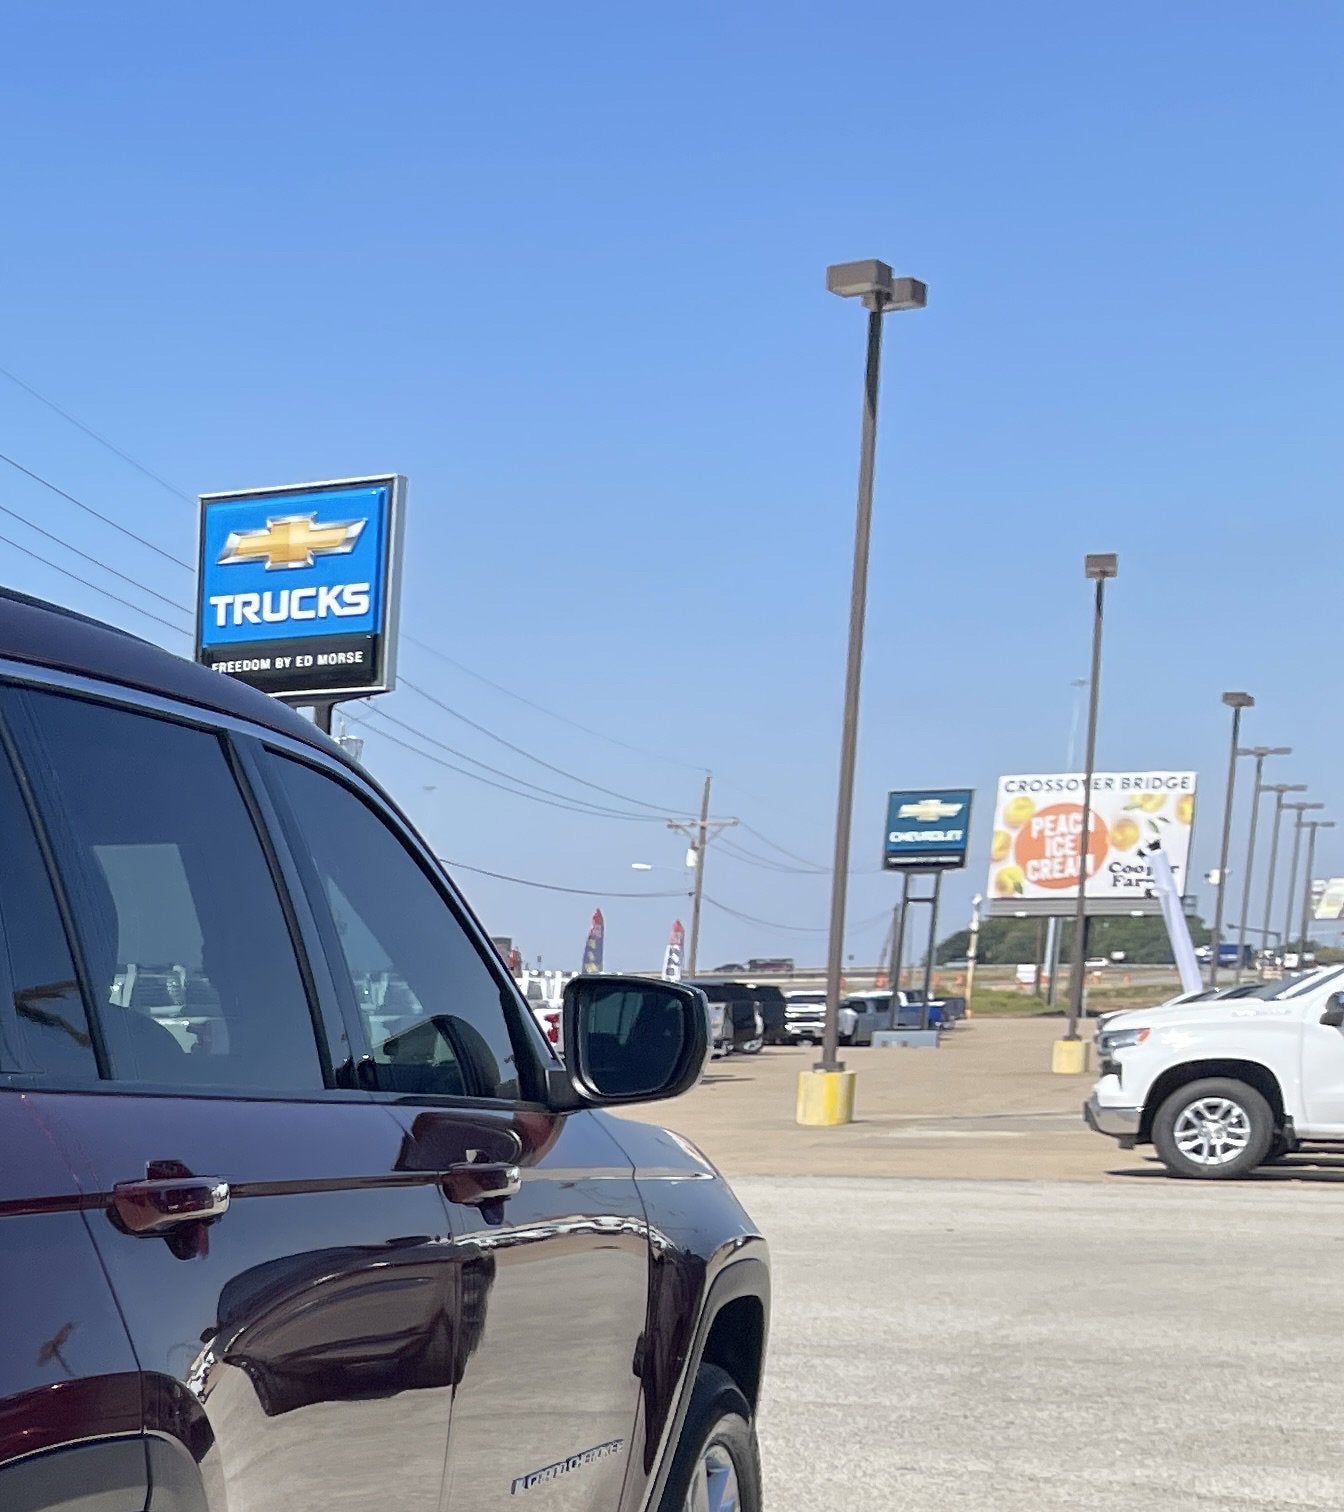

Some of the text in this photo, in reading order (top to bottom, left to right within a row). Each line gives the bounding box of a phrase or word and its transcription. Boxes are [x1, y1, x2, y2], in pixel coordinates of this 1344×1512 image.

[210, 582, 370, 627] TRUCKS
[211, 651, 364, 674] FREEDOM BY ED MORSE
[1121, 776, 1191, 791] BRIDGE
[1045, 835, 1079, 857] ICE
